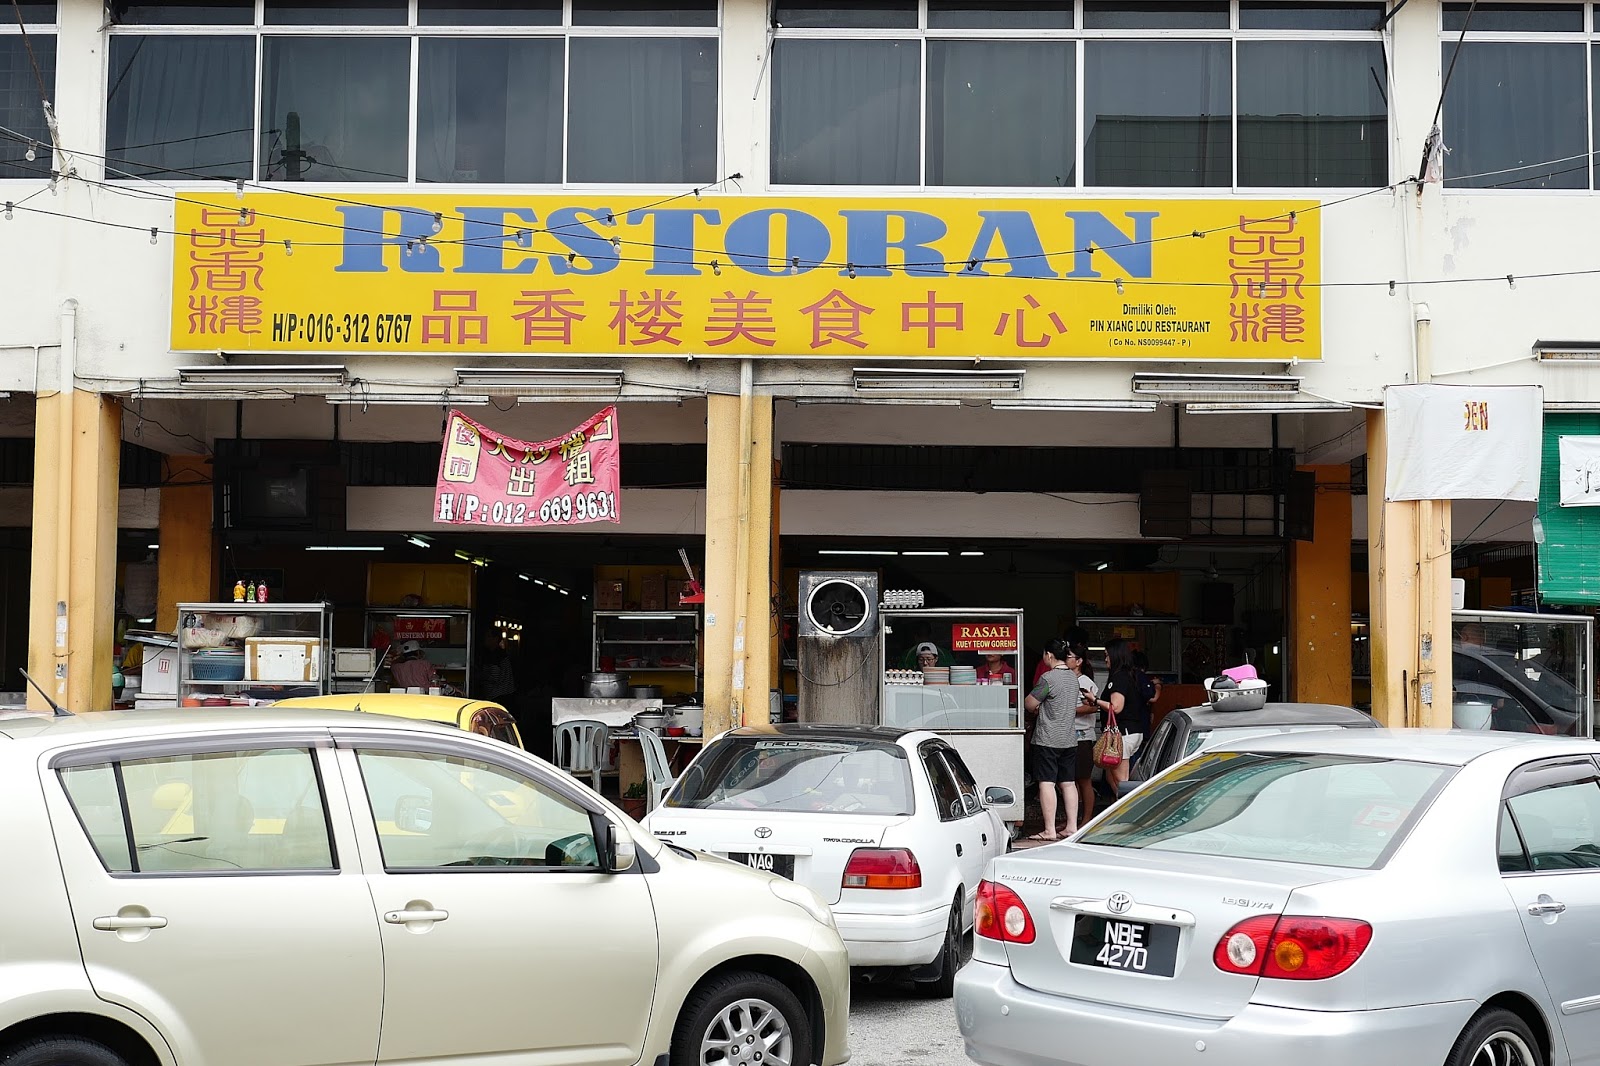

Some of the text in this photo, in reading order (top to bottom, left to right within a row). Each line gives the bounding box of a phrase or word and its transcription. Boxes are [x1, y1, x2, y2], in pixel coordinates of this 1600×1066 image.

[335, 205, 1159, 278] RESTORAN
[421, 288, 1067, 349] 品香楼美食中心
[1123, 304, 1177, 315] Dimiliki Oleh:
[376, 314, 412, 344] 6767
[1090, 320, 1210, 333] PIN XIANG LOU RESTAURANT
[961, 626, 1011, 638] RASAH
[955, 640, 1016, 648] KUEY TEOW GORENG
[748, 853, 773, 870] NAQ
[1104, 921, 1145, 948] NBE
[1096, 943, 1148, 970] 4270
